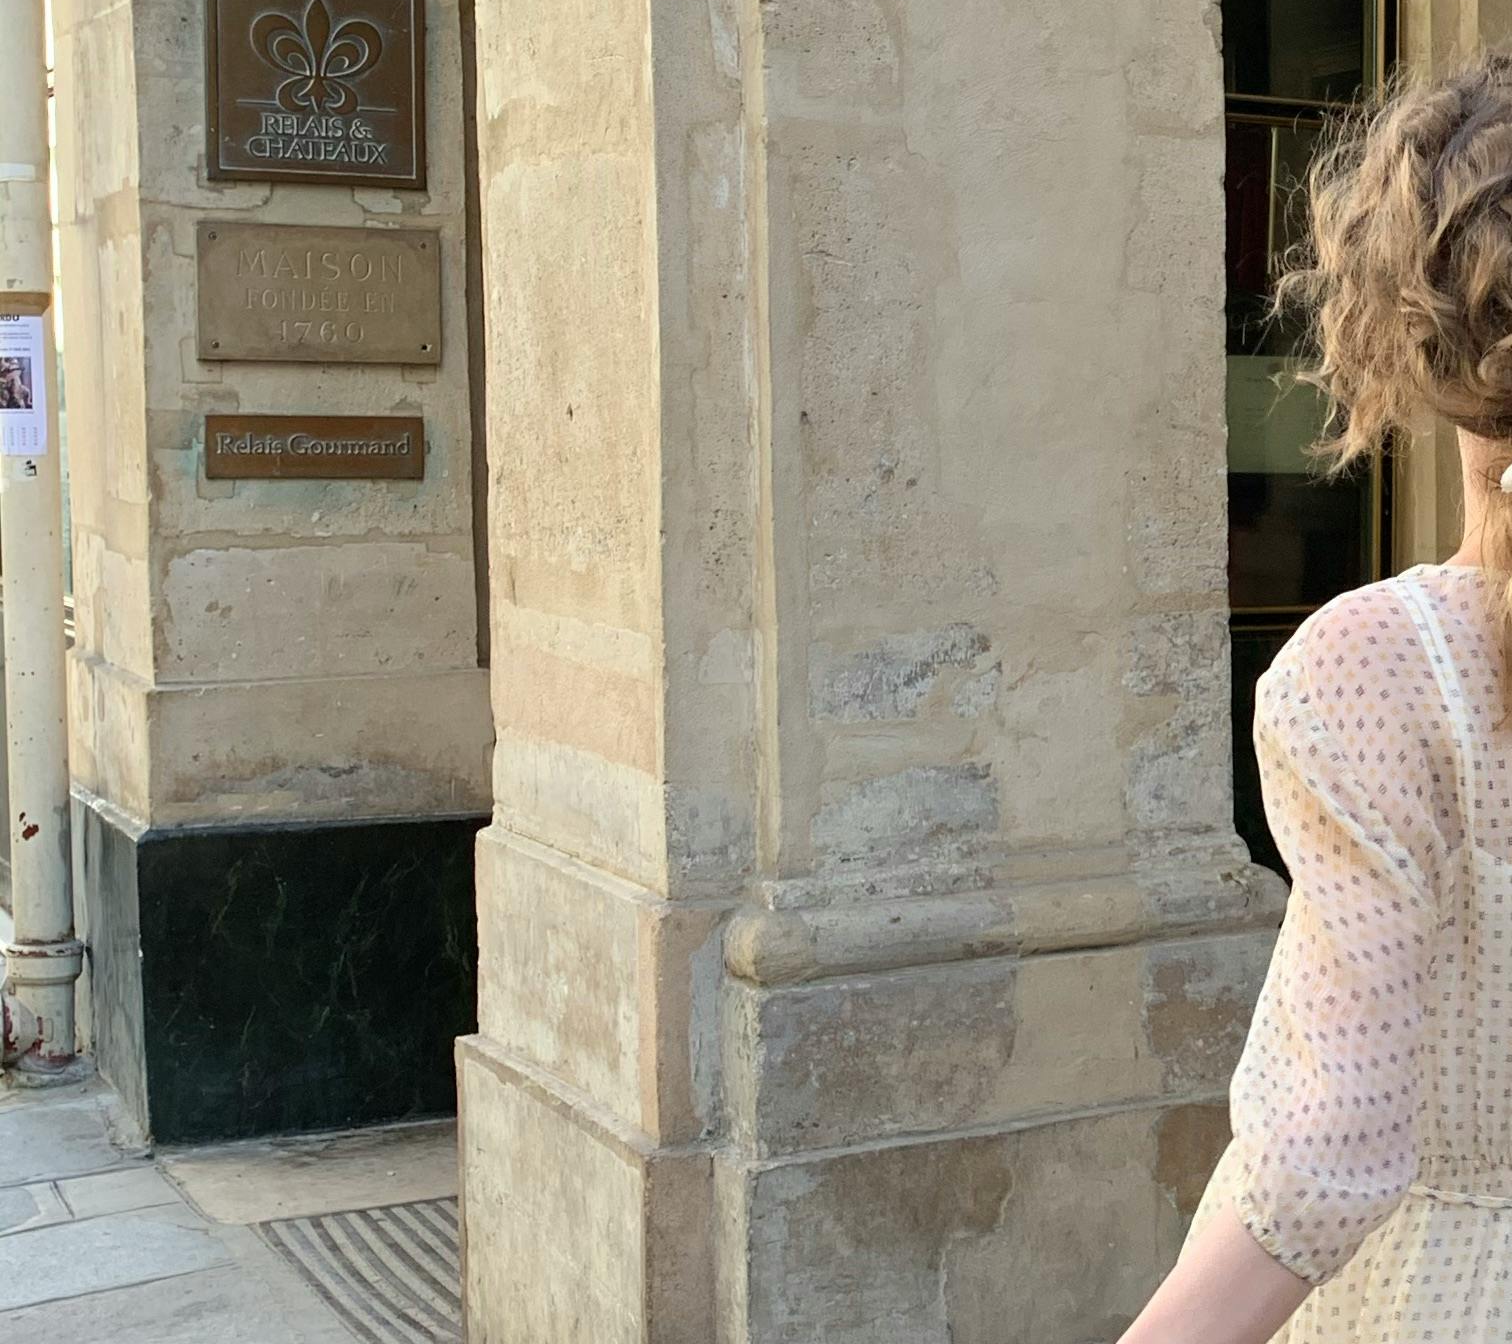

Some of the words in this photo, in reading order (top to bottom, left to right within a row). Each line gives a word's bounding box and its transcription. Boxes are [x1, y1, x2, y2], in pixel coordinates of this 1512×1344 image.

[259, 112, 344, 138] RELAIS
[349, 118, 373, 140] &
[236, 247, 403, 283] MAISON
[246, 287, 349, 312] FONDÉE
[364, 291, 396, 313] EN
[276, 319, 365, 344] 1760
[215, 431, 284, 455] Relais
[287, 431, 411, 457] Gourmand
